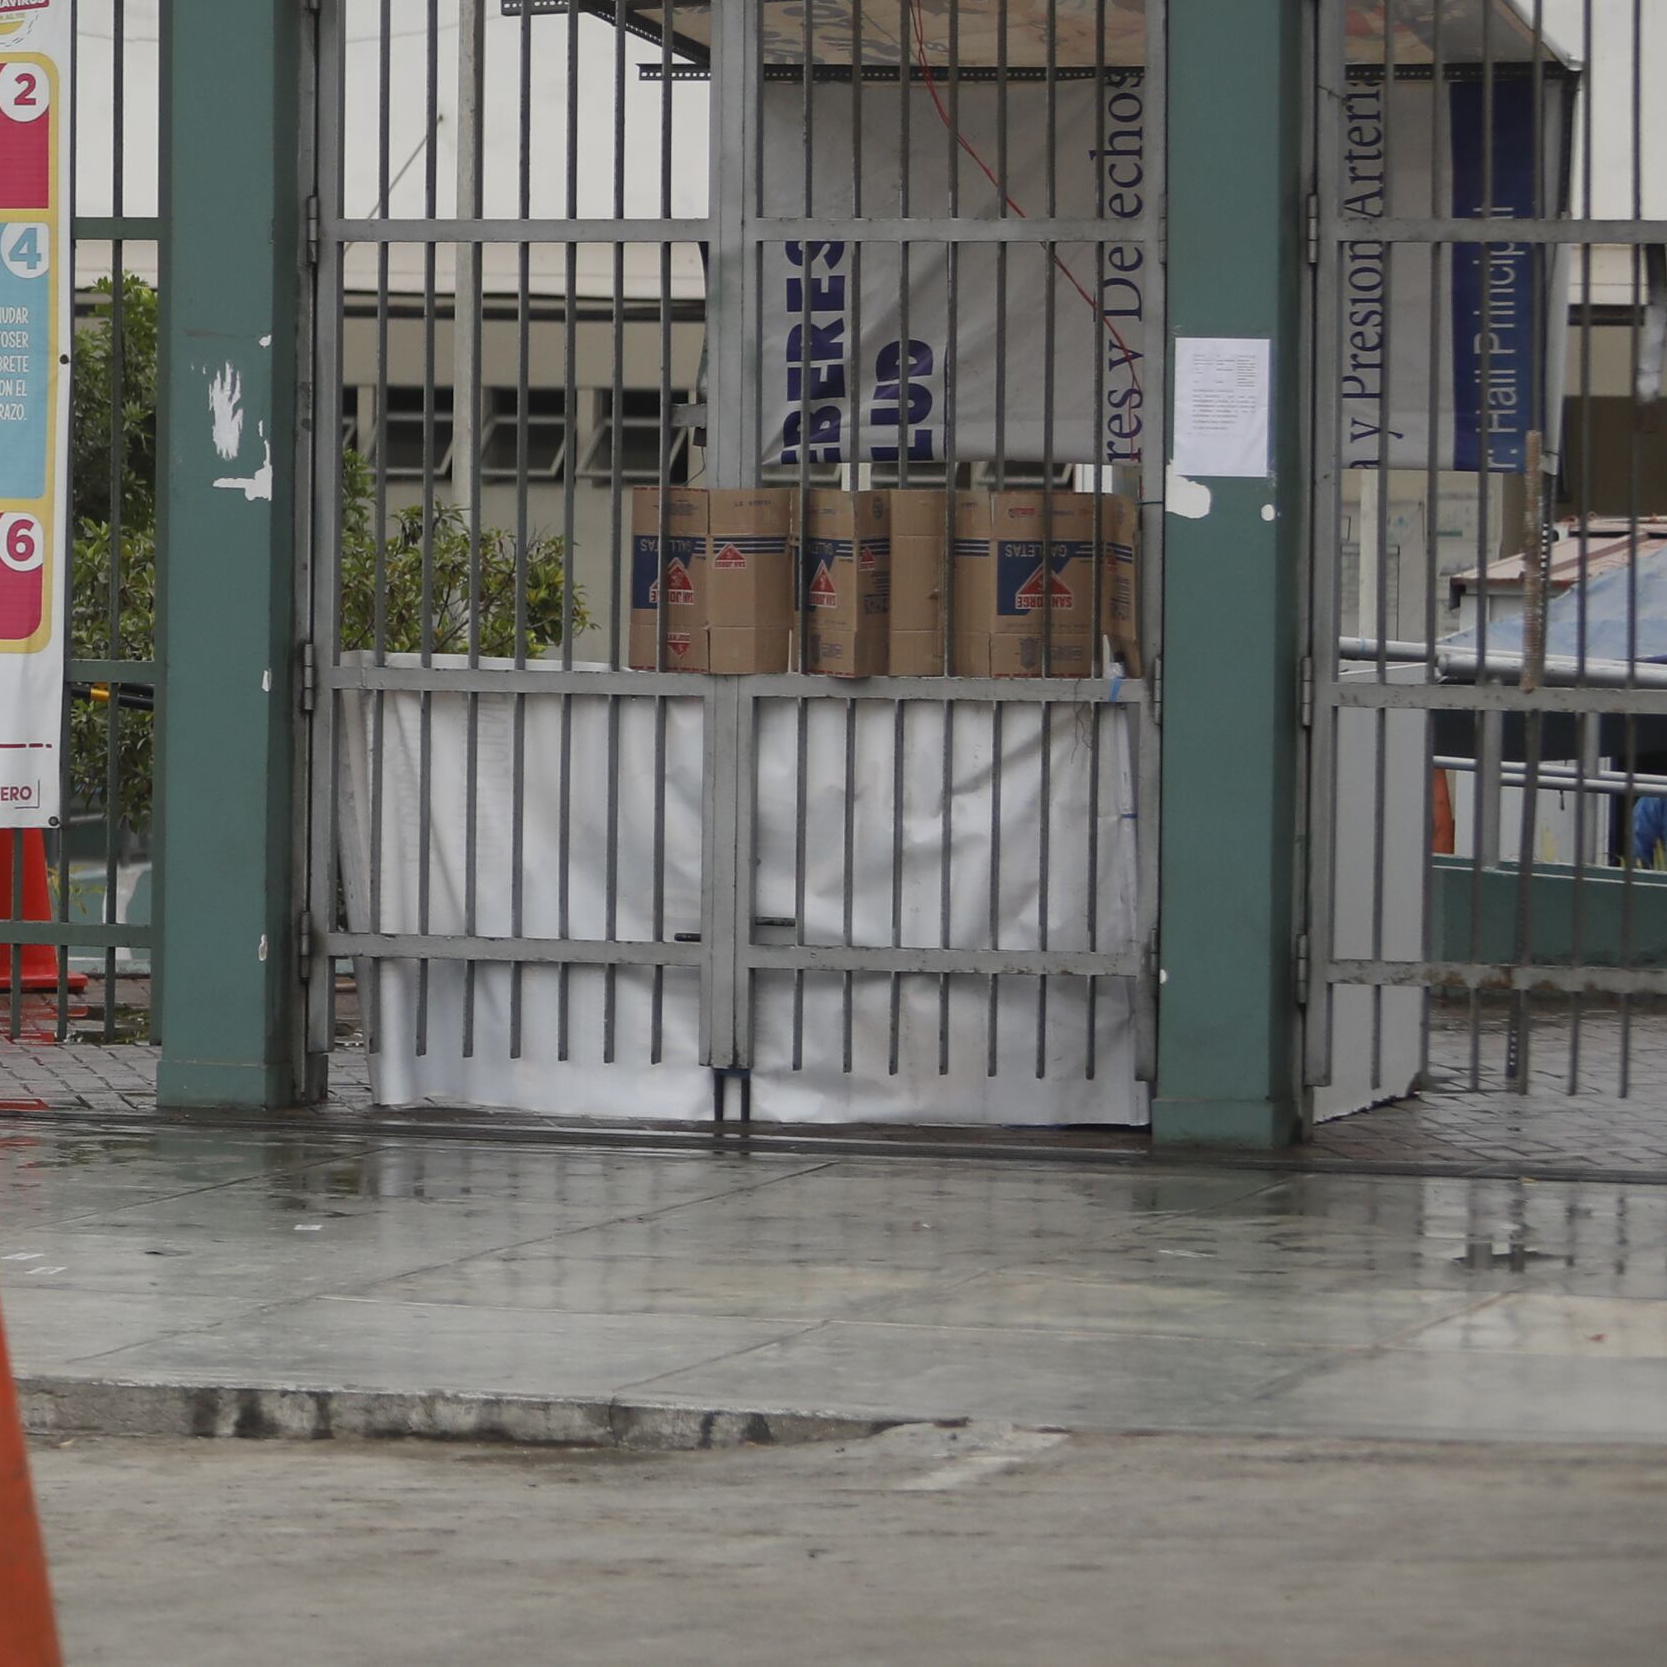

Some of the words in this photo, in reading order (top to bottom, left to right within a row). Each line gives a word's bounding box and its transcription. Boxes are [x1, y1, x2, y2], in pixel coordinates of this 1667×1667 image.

[14, 73, 36, 106] 2
[1089, 74, 1144, 322] Deechos
[9, 227, 42, 270] 4
[16, 380, 27, 396] EL
[1474, 369, 1518, 434] Hall
[6, 518, 35, 562] 6
[1005, 544, 1067, 558] GALETAS
[1017, 596, 1043, 608] ORGE
